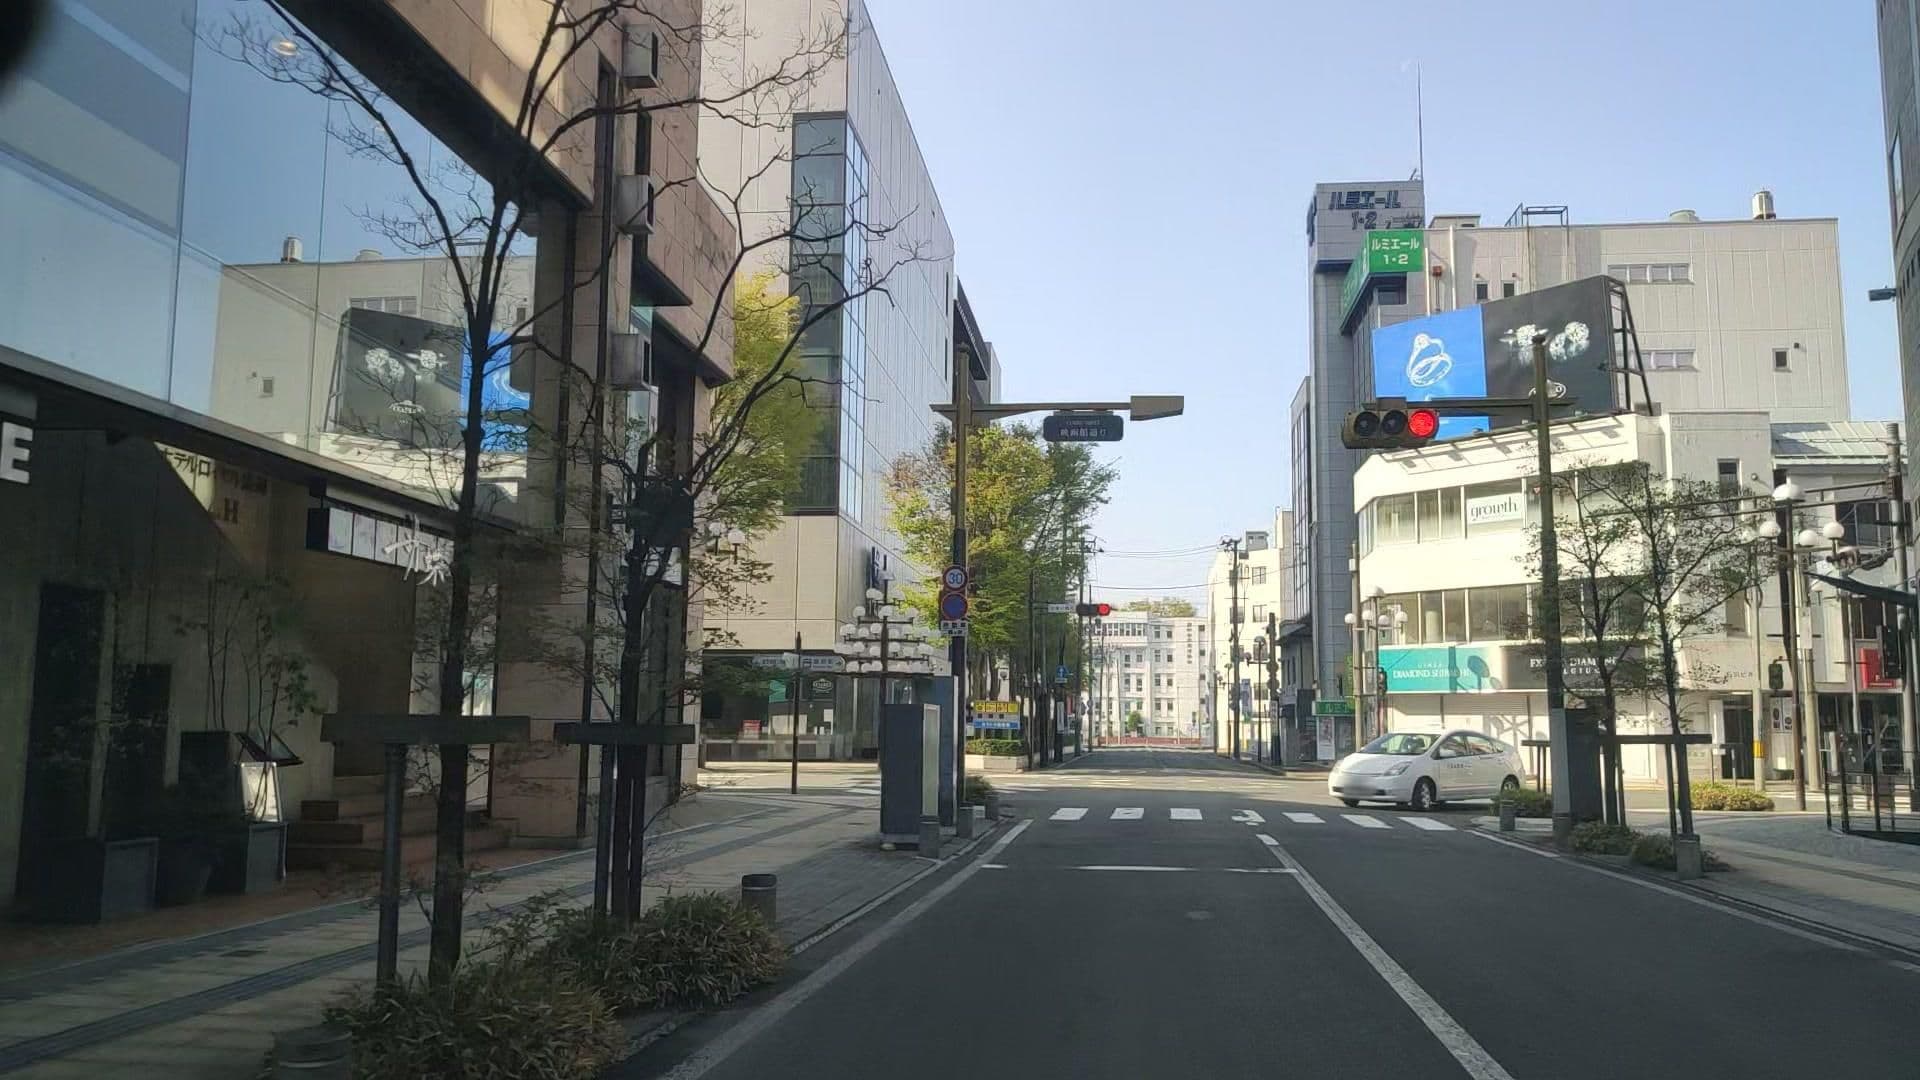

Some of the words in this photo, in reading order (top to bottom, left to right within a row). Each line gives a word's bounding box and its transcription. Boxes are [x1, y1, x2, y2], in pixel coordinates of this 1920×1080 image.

[1371, 238, 1420, 250] ルミエール
[1471, 496, 1517, 521] growth
[949, 572, 962, 584] 30
